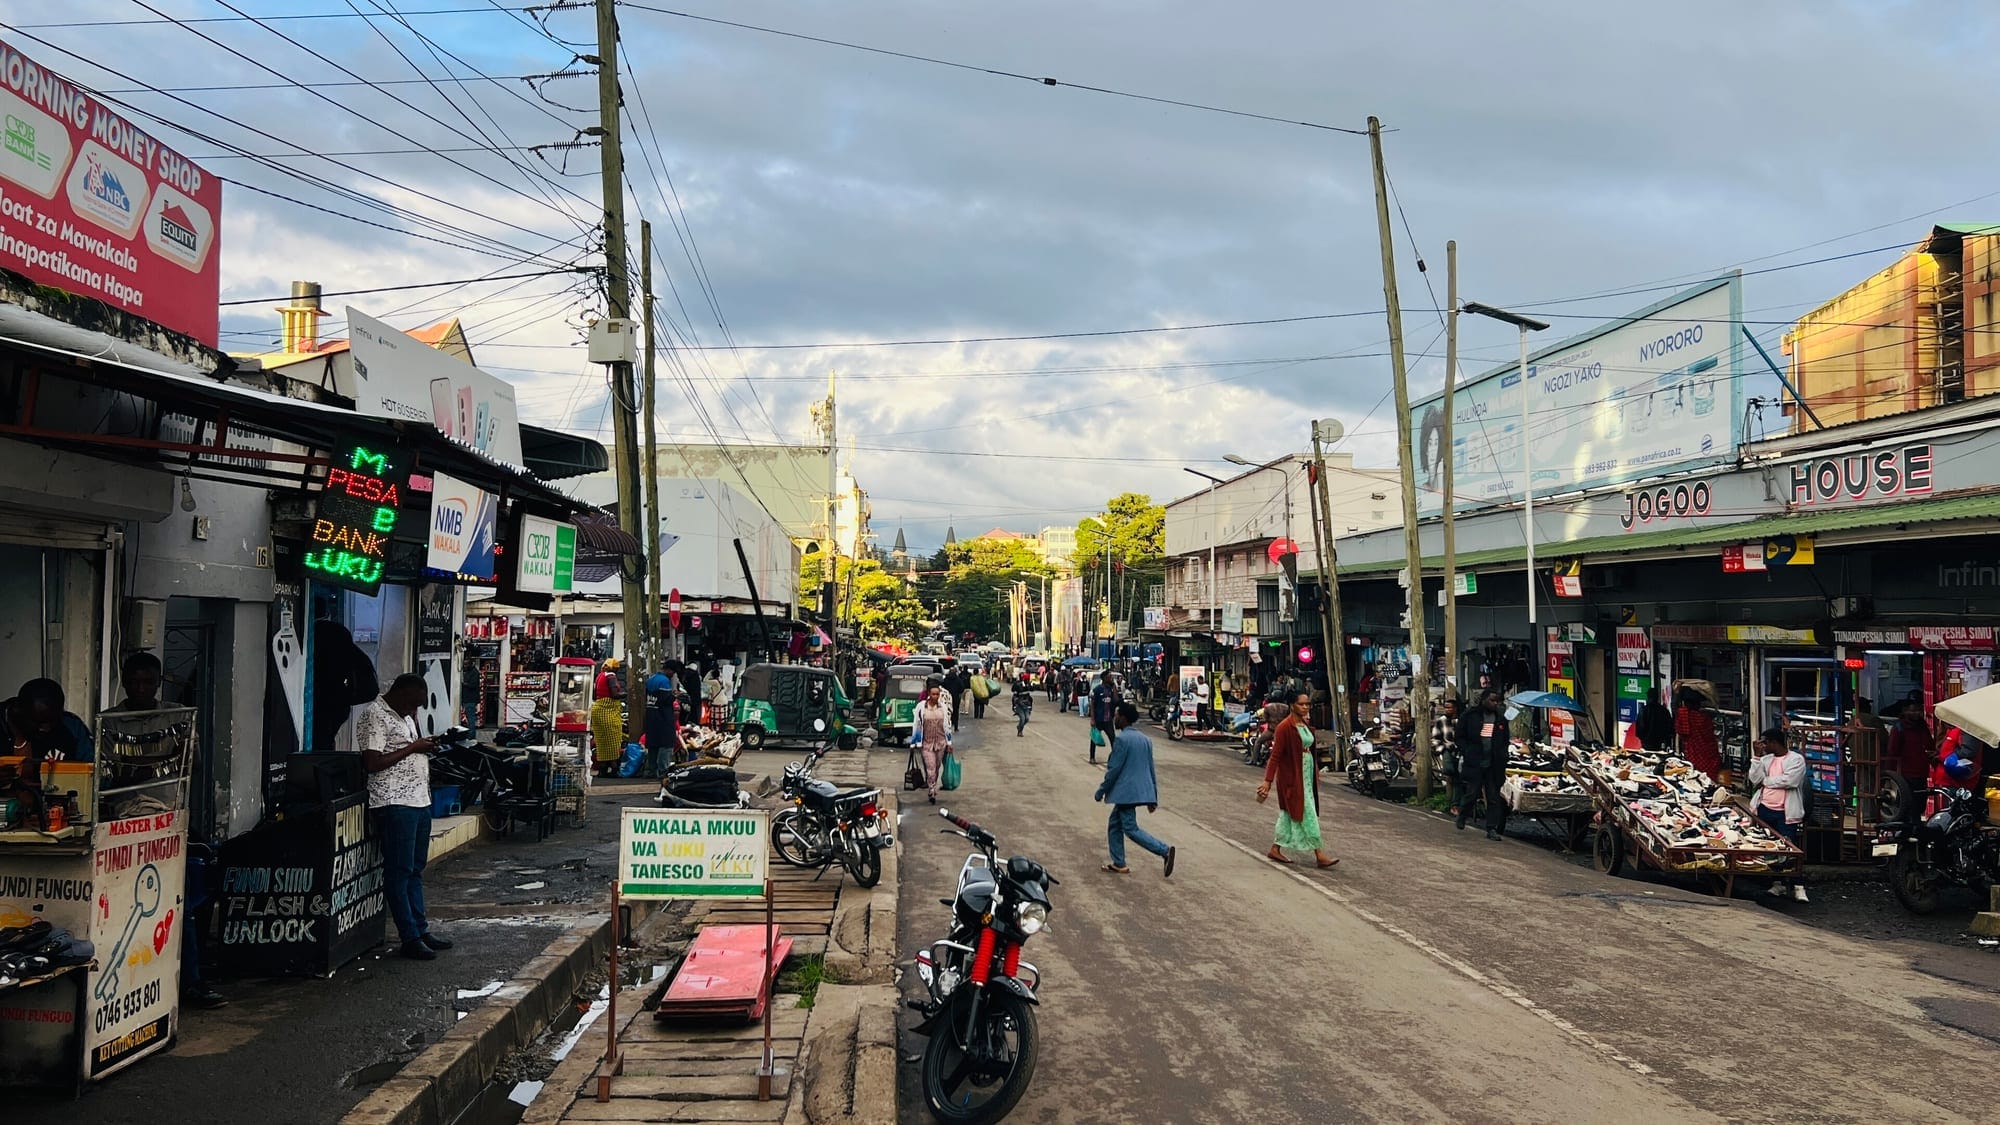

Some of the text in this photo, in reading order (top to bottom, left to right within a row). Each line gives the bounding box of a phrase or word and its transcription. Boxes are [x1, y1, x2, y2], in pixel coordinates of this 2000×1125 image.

[0, 48, 201, 197] ORNING MONEY SHOP
[6, 133, 34, 160] BANK
[106, 186, 129, 211] NBC
[36, 212, 57, 237] za
[60, 220, 138, 273] Mawakala
[162, 220, 195, 248] EQUITY
[104, 272, 143, 307] Hapa
[1639, 324, 1703, 363] NYORORO
[1544, 373, 1572, 395] NGOZI
[1574, 361, 1602, 385] YAKO
[352, 446, 386, 475] M
[326, 467, 399, 506] PESA
[1789, 445, 1934, 505] HOUSE
[1620, 480, 1712, 531] JOGOO
[434, 504, 462, 536] NMB
[312, 518, 388, 558] BANK
[433, 534, 461, 555] WAKALA
[258, 548, 266, 565] 16
[303, 548, 385, 583] LUKU
[523, 561, 552, 577] WAKALA
[1832, 630, 1906, 644] TUNAKOPESHA SIMU
[1968, 626, 1993, 640] SIMU
[109, 811, 174, 836] MASTER KP
[335, 802, 365, 852] FUNDI
[632, 818, 756, 836] WAKALA MKUU
[96, 834, 181, 876] FUNDI FUNGUO
[632, 841, 657, 857] WA
[663, 841, 705, 858] LUKU
[224, 866, 314, 894] FUNDI SIMU
[631, 863, 704, 879] TANESCO
[35, 877, 92, 901] FUNGUO
[227, 894, 329, 917] FLASH &
[223, 918, 317, 945] UNLOCK
[96, 978, 160, 1034] 0746 933 801
